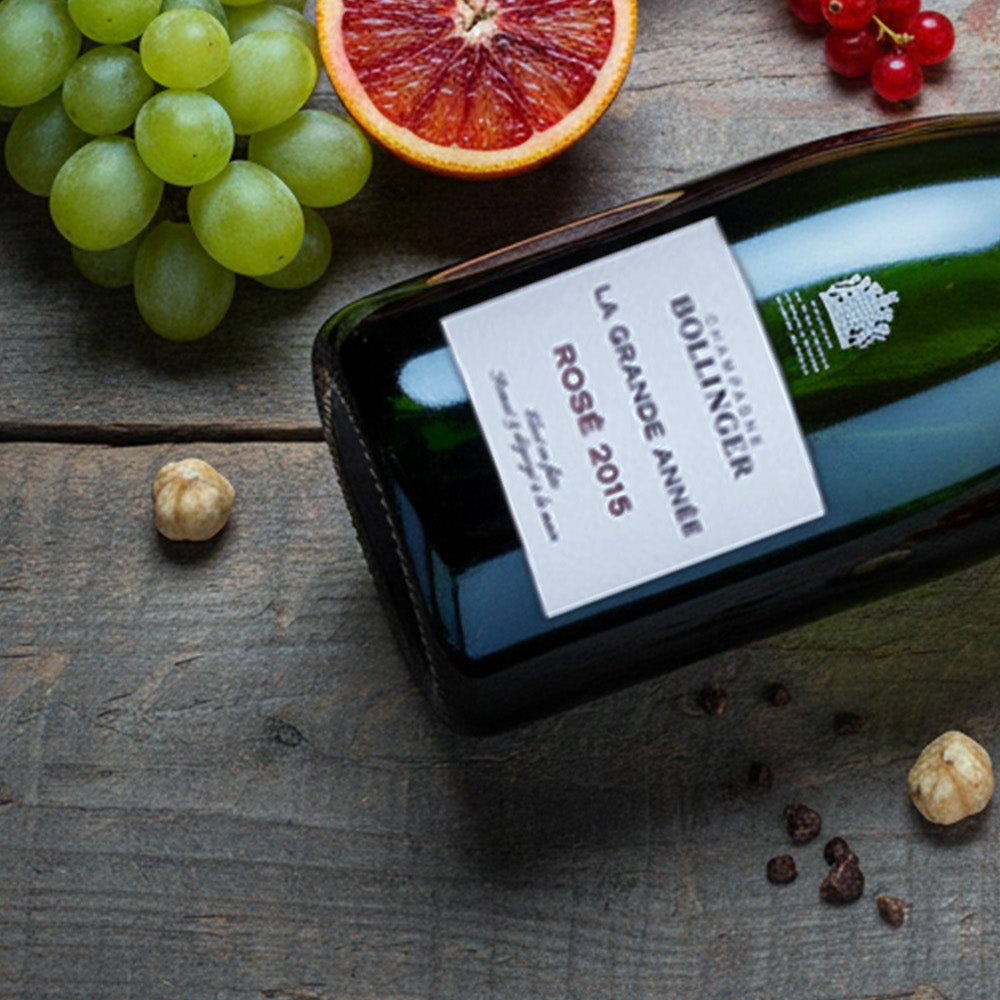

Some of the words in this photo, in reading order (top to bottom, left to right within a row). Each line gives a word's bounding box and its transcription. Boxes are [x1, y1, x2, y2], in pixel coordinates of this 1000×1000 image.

[552, 342, 605, 438] ROSÉ
[587, 442, 634, 518] 2015
[593, 281, 620, 321] LA
[608, 323, 667, 443] GRANDE
[652, 438, 704, 538] ANNÉE
[670, 294, 755, 480] BOLLINGER
[705, 313, 765, 448] CHAMPAGNE
